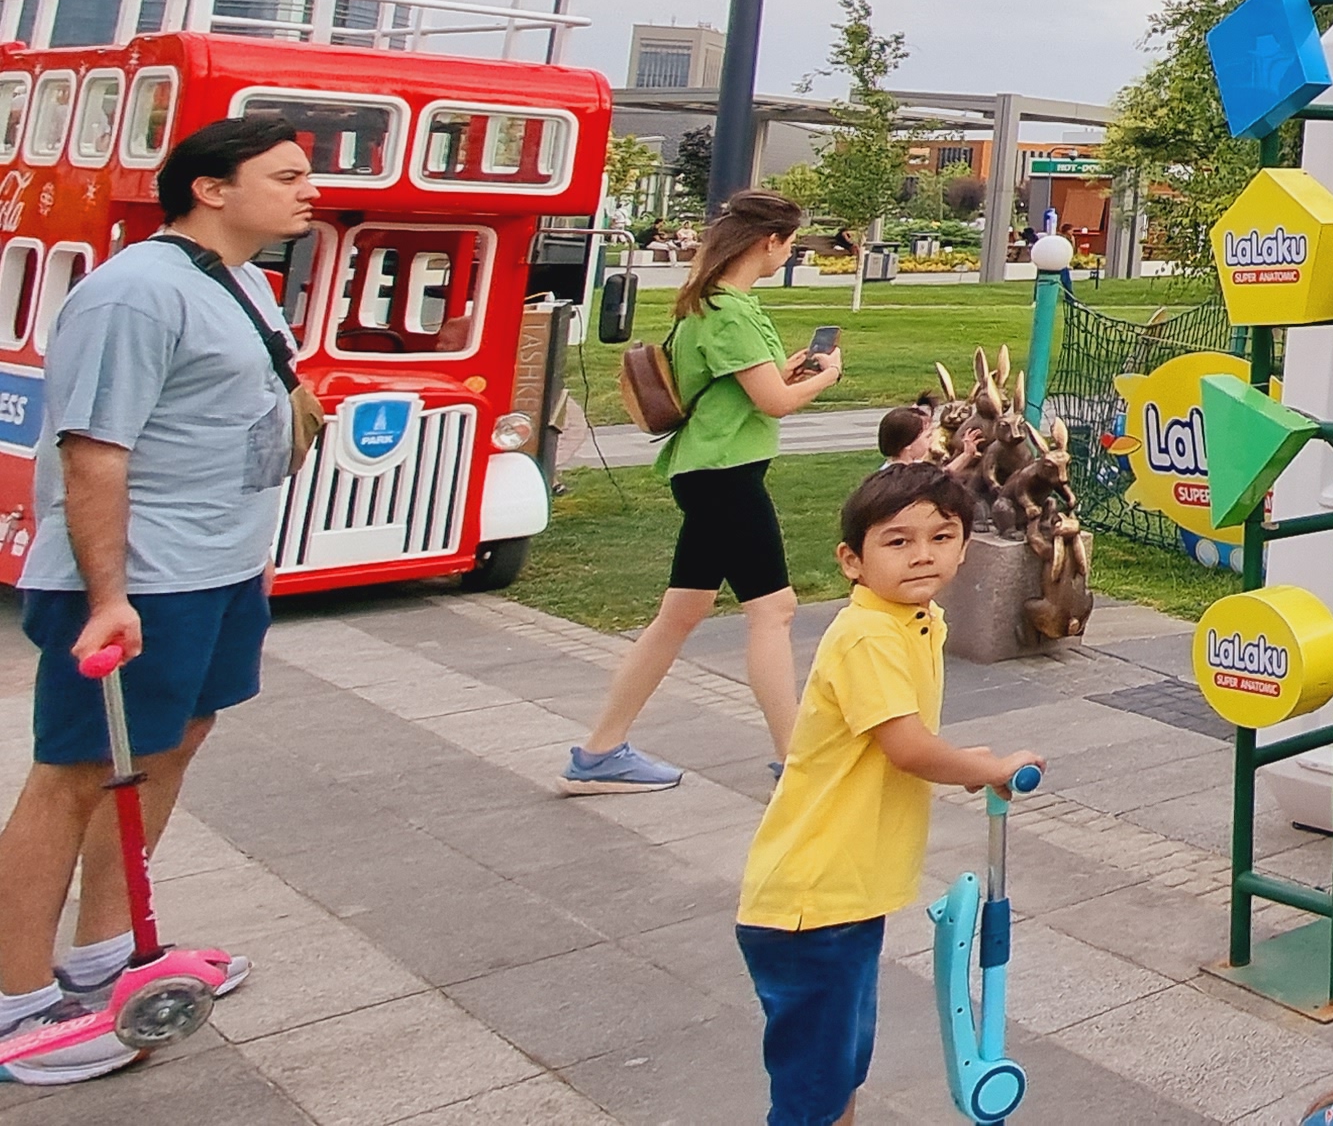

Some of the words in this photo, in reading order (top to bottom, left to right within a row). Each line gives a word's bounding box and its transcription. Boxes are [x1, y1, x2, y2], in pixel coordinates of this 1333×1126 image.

[1234, 272, 1257, 283] SUPER
[515, 323, 546, 414] TASHKE
[1216, 674, 1239, 688] SUPER
